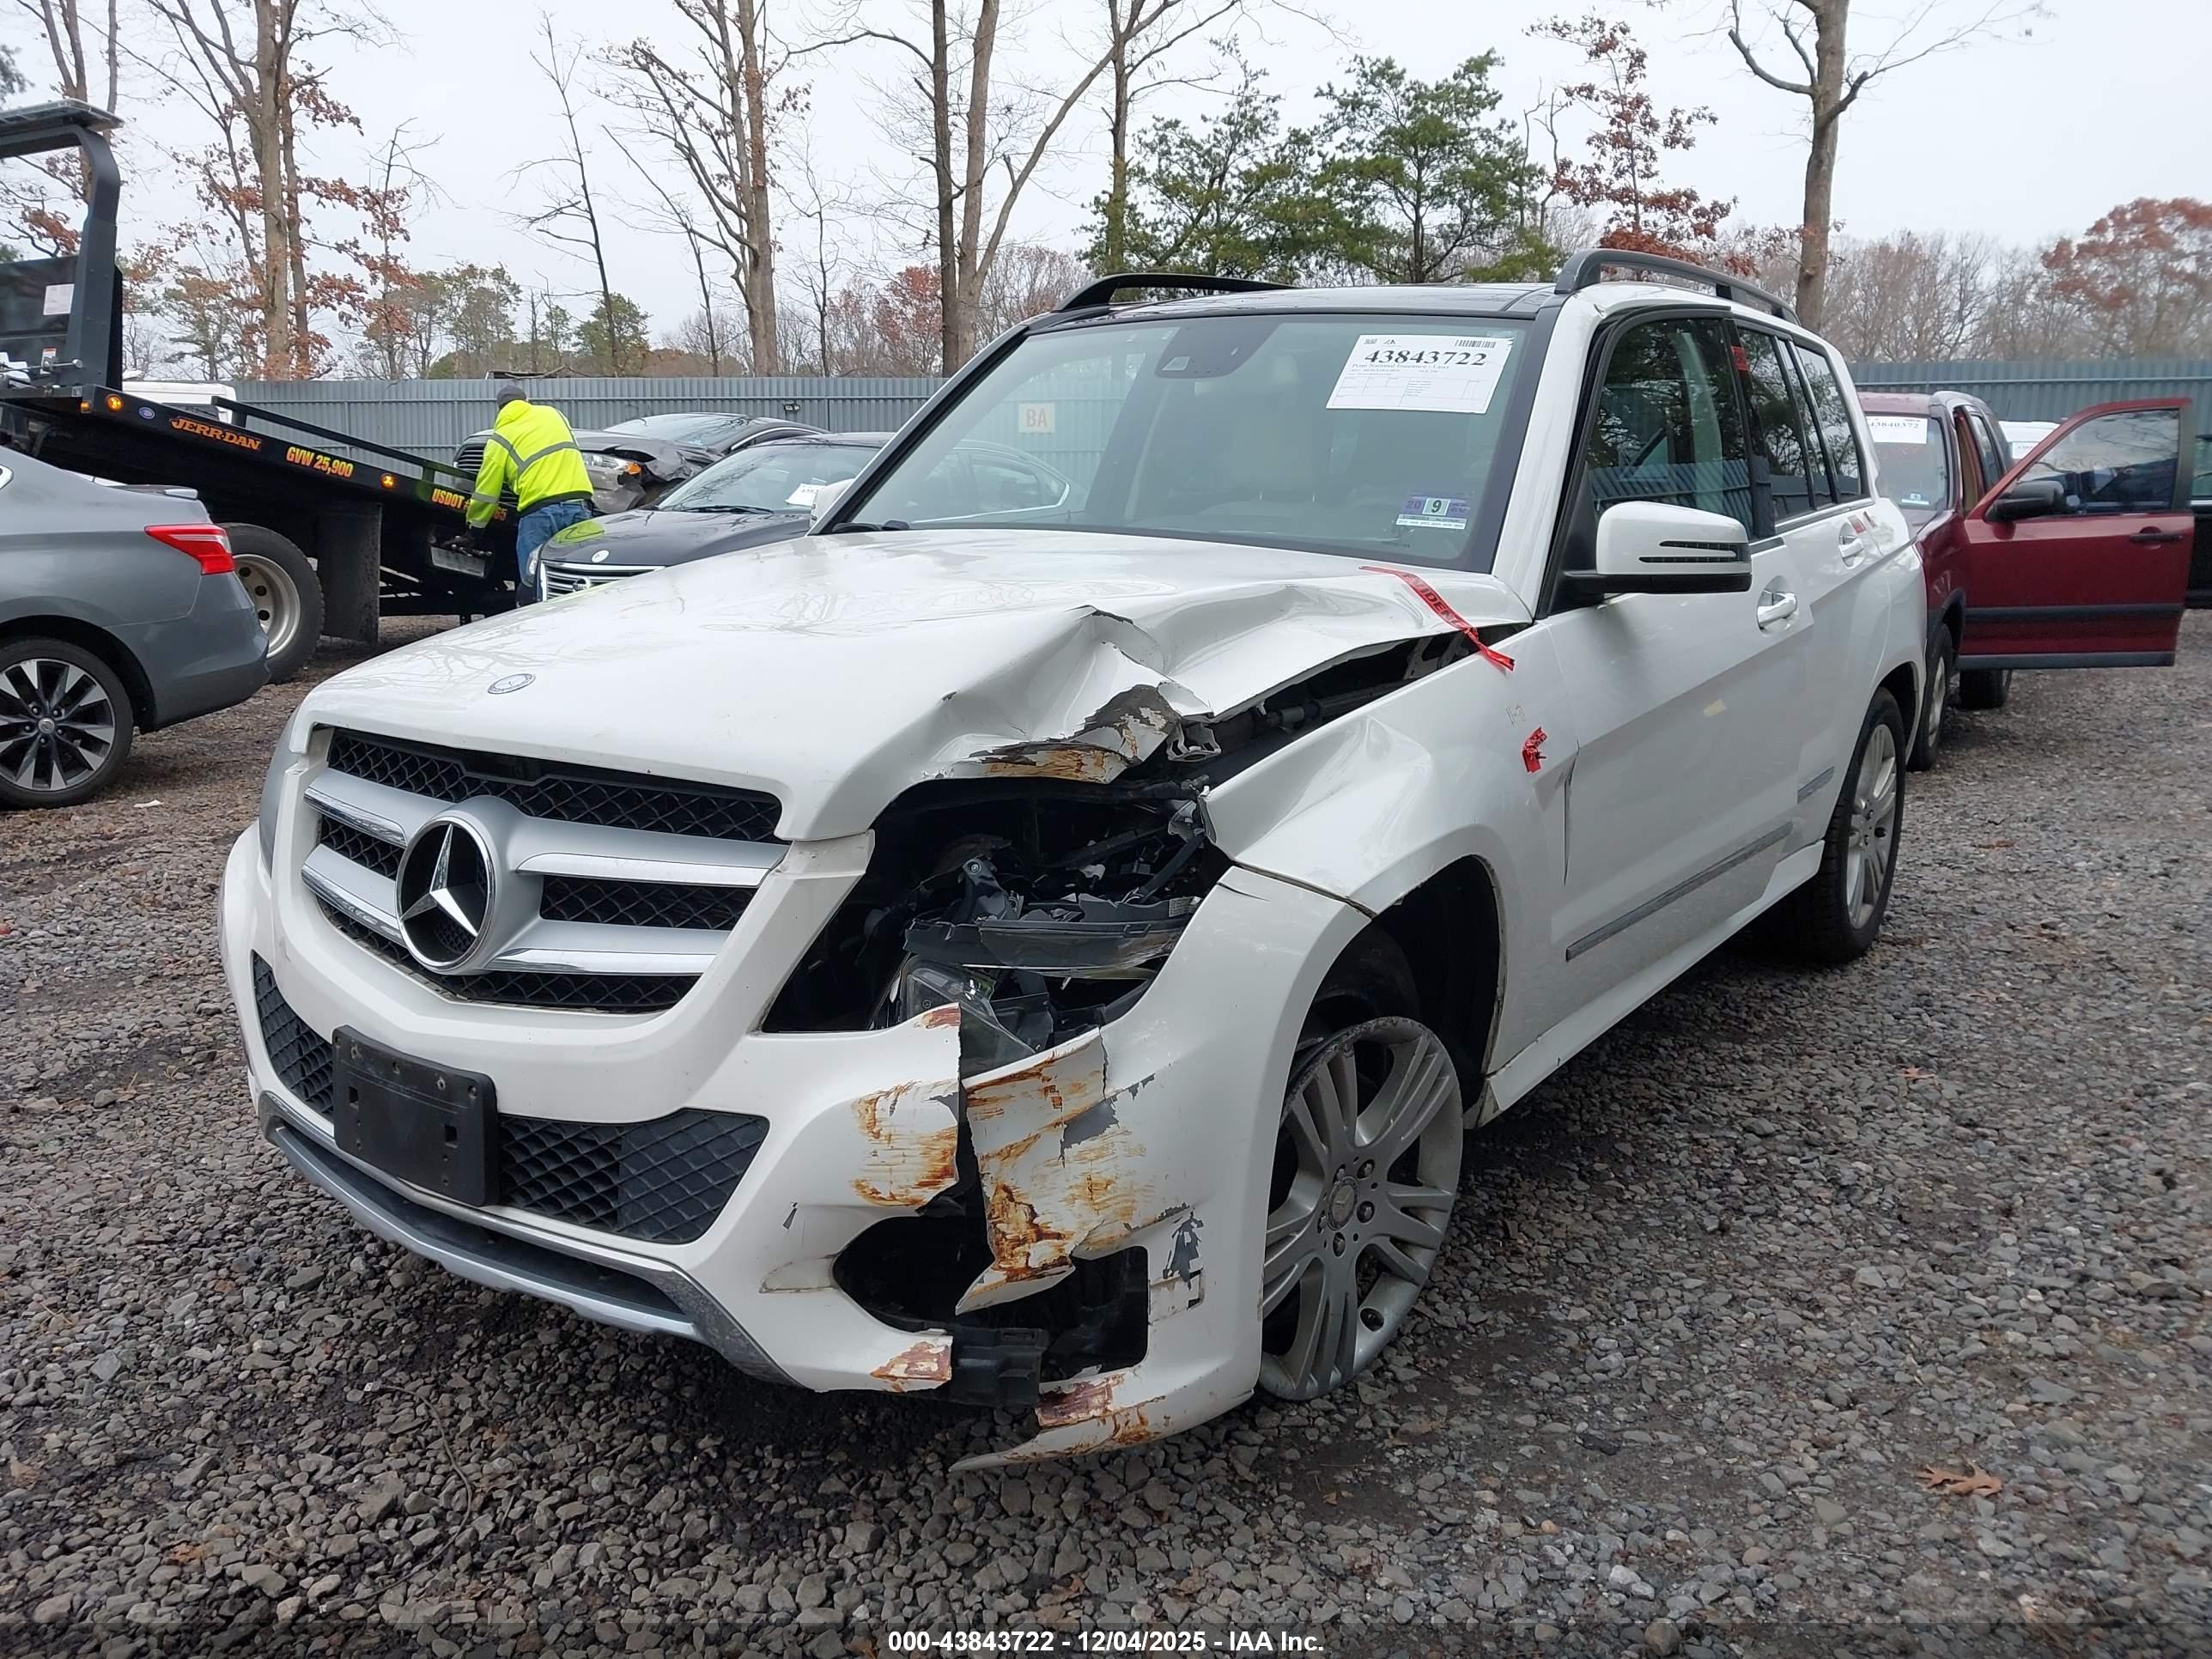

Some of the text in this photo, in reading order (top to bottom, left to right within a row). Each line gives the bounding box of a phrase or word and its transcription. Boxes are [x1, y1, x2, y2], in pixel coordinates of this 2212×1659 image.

[1364, 349, 1487, 366] 43843722
[286, 446, 354, 477] GVW 25,900
[432, 488, 465, 508] USDOT
[1431, 500, 1442, 513] 9
